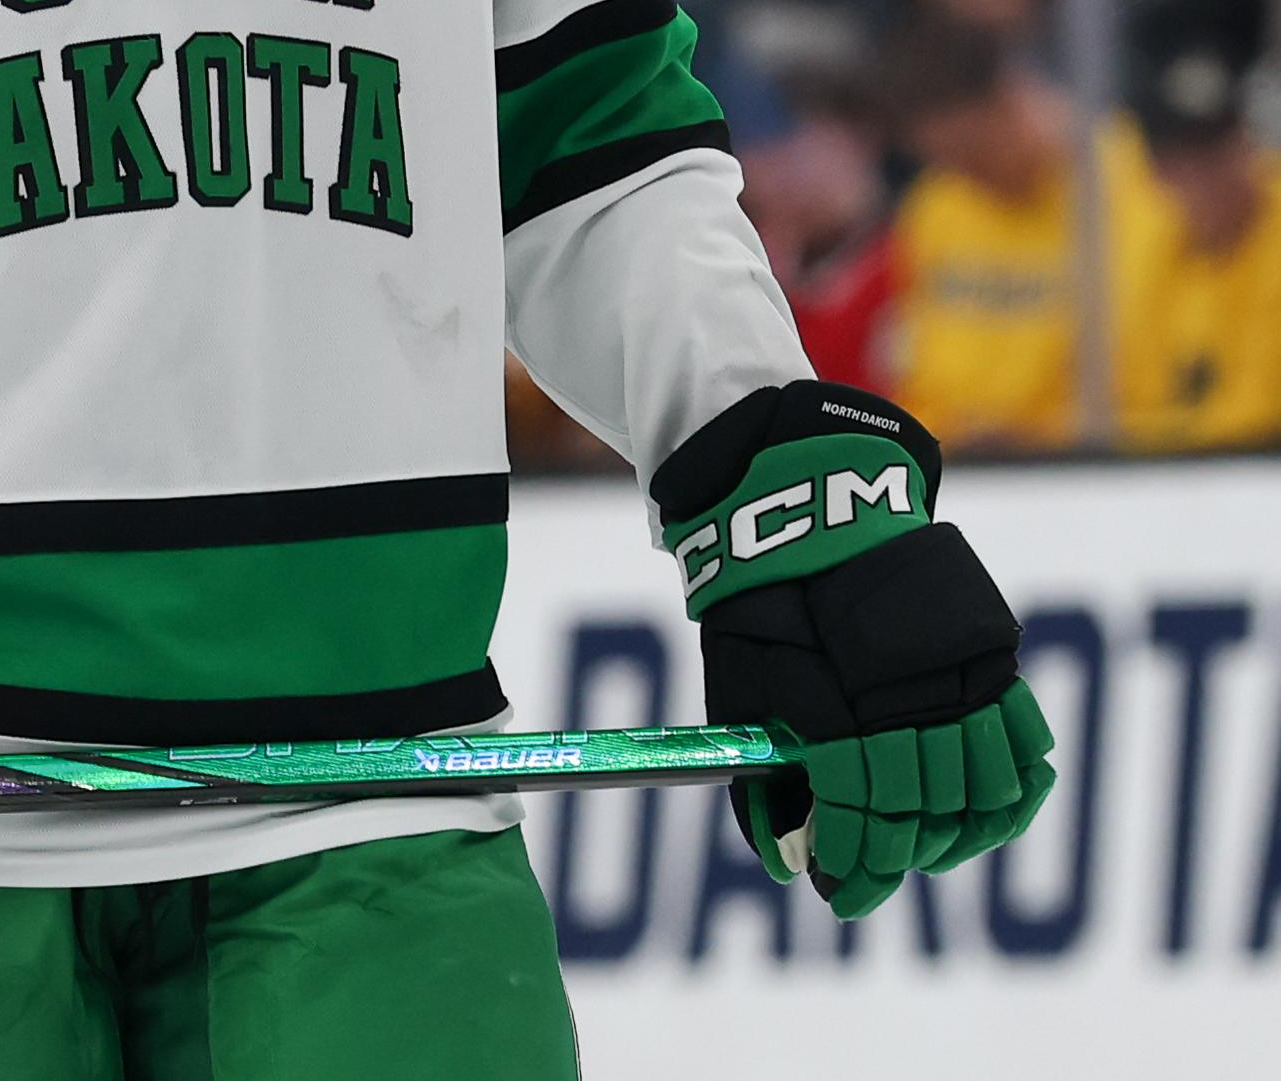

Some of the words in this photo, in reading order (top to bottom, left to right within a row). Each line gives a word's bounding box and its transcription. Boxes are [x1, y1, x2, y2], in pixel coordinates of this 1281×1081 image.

[821, 400, 861, 421] NORTH
[860, 411, 901, 433] DAKOTA
[674, 464, 914, 601] CCM
[443, 747, 582, 772] BAUER
